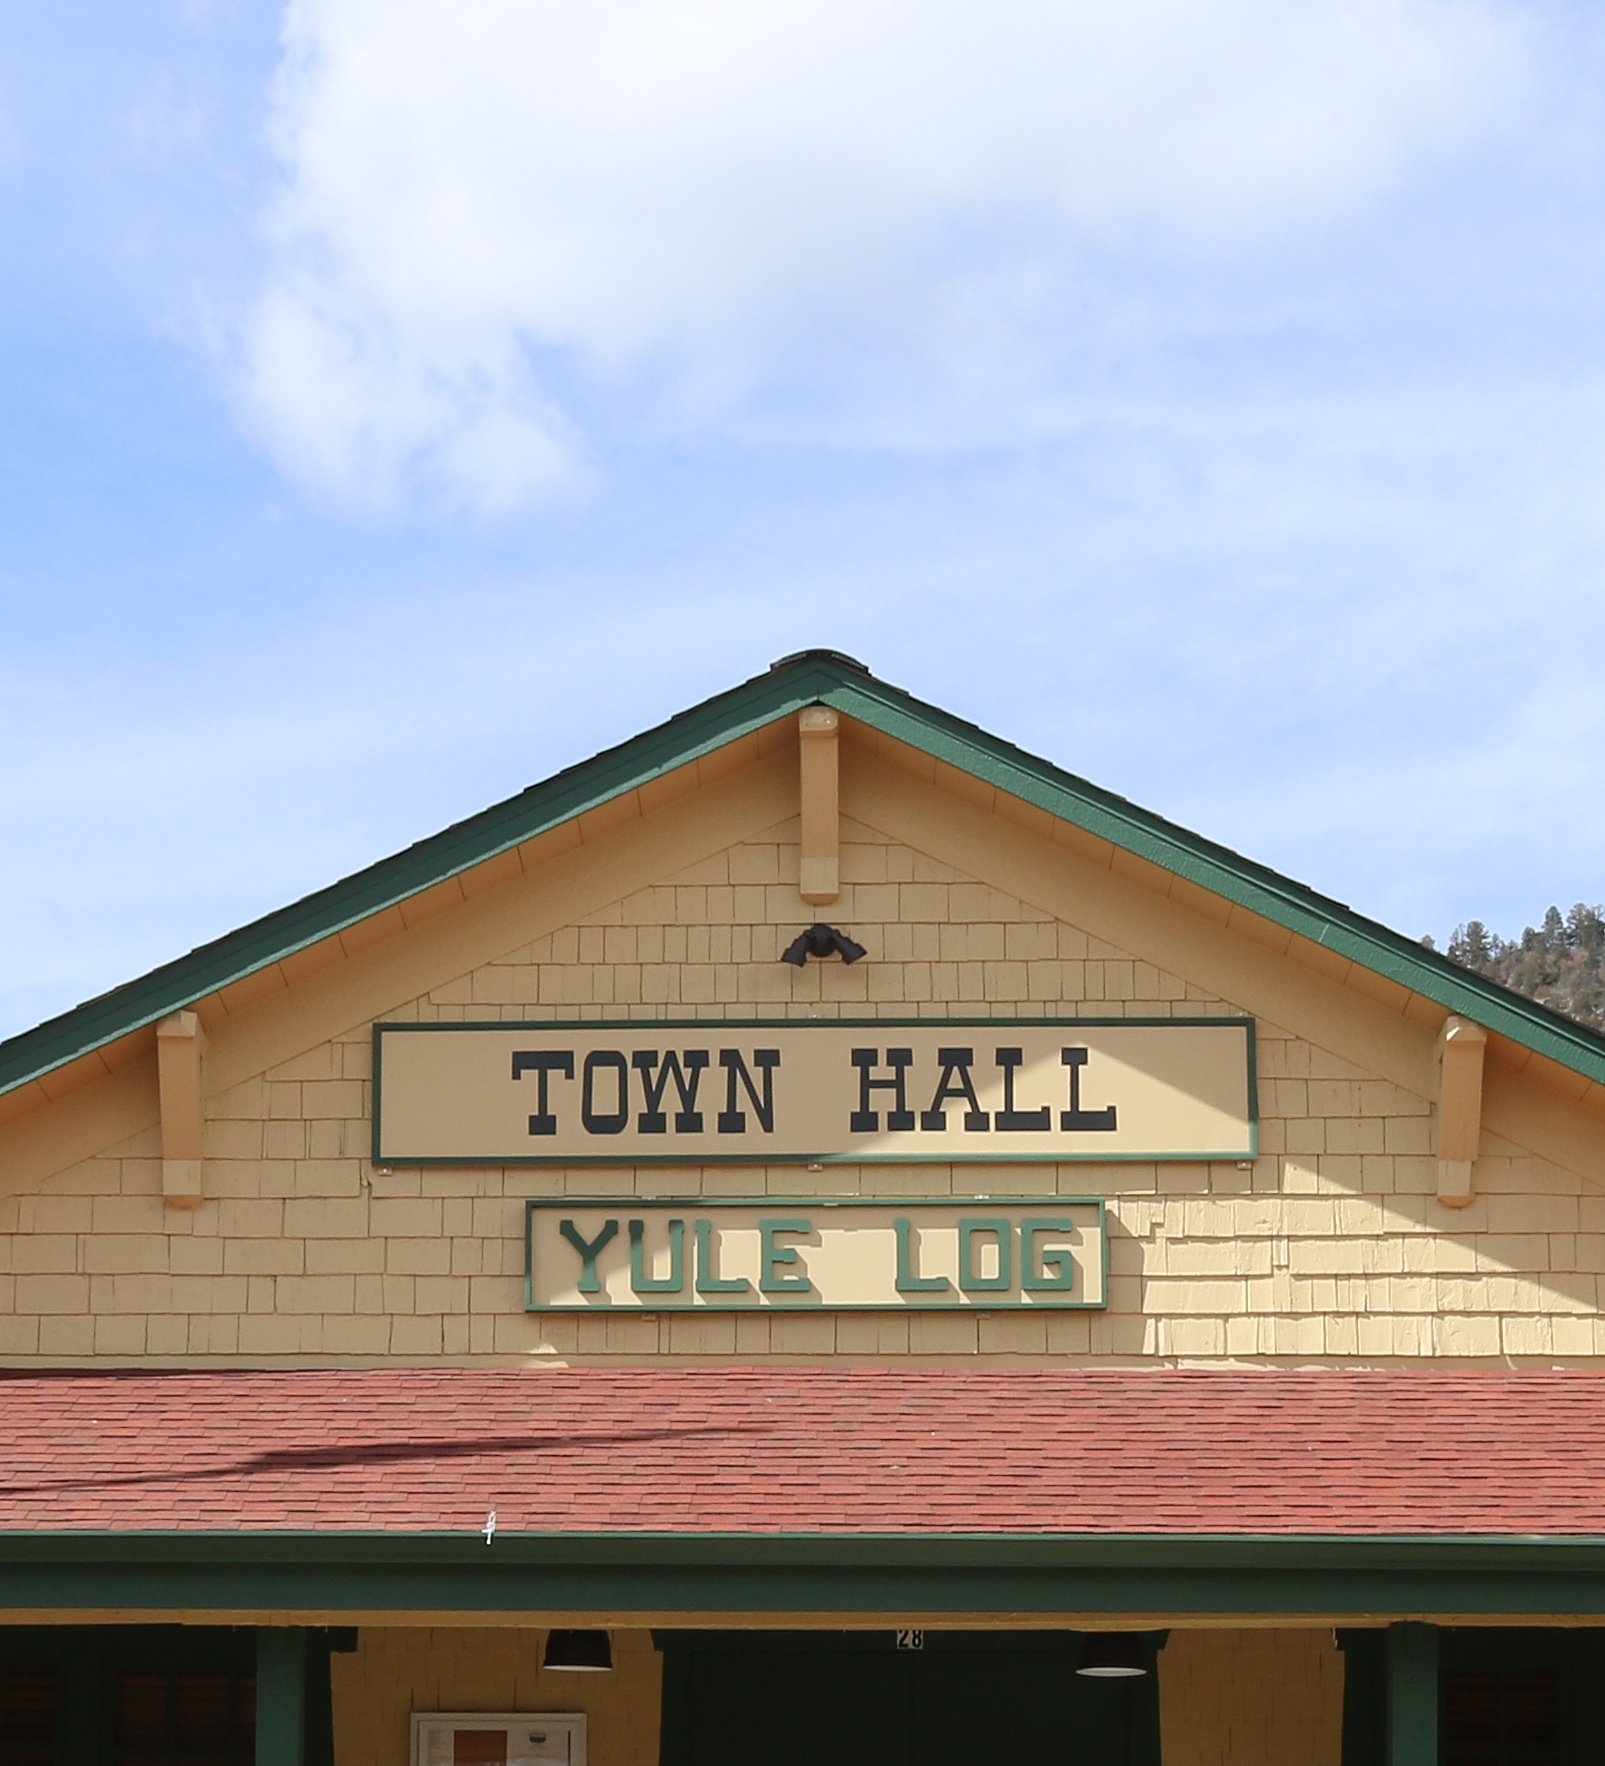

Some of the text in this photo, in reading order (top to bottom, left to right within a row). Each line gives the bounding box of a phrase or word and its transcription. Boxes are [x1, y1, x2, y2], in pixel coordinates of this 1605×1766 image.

[511, 1047, 1117, 1135] TOWN HALL
[559, 1218, 1073, 1292] YULE LOG
[898, 1629, 922, 1648] 28
